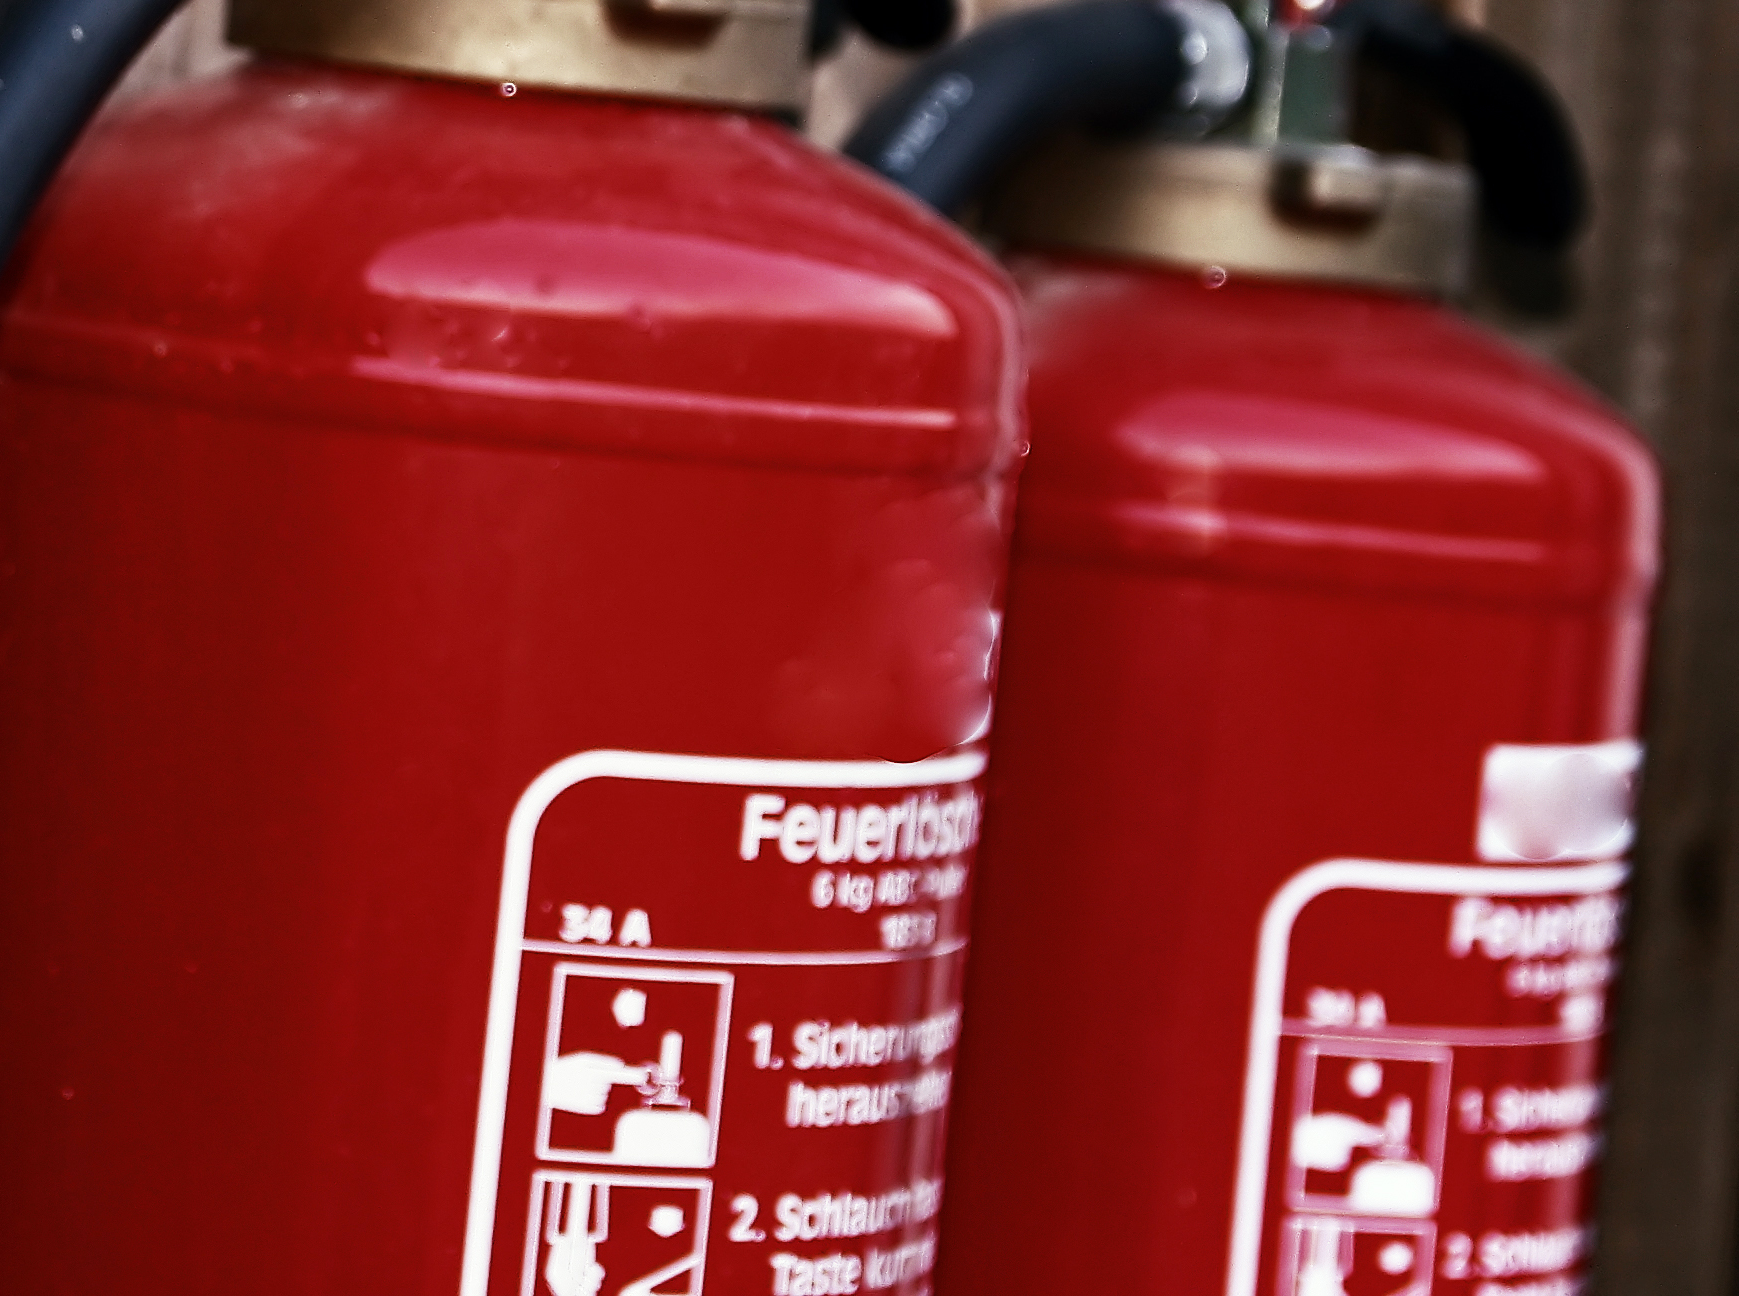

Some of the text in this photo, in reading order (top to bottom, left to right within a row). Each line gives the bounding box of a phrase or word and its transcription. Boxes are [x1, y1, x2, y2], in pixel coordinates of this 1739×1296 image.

[559, 903, 653, 947] 34 A
[748, 1021, 784, 1070] 1.
[728, 1193, 766, 1242] 2.
